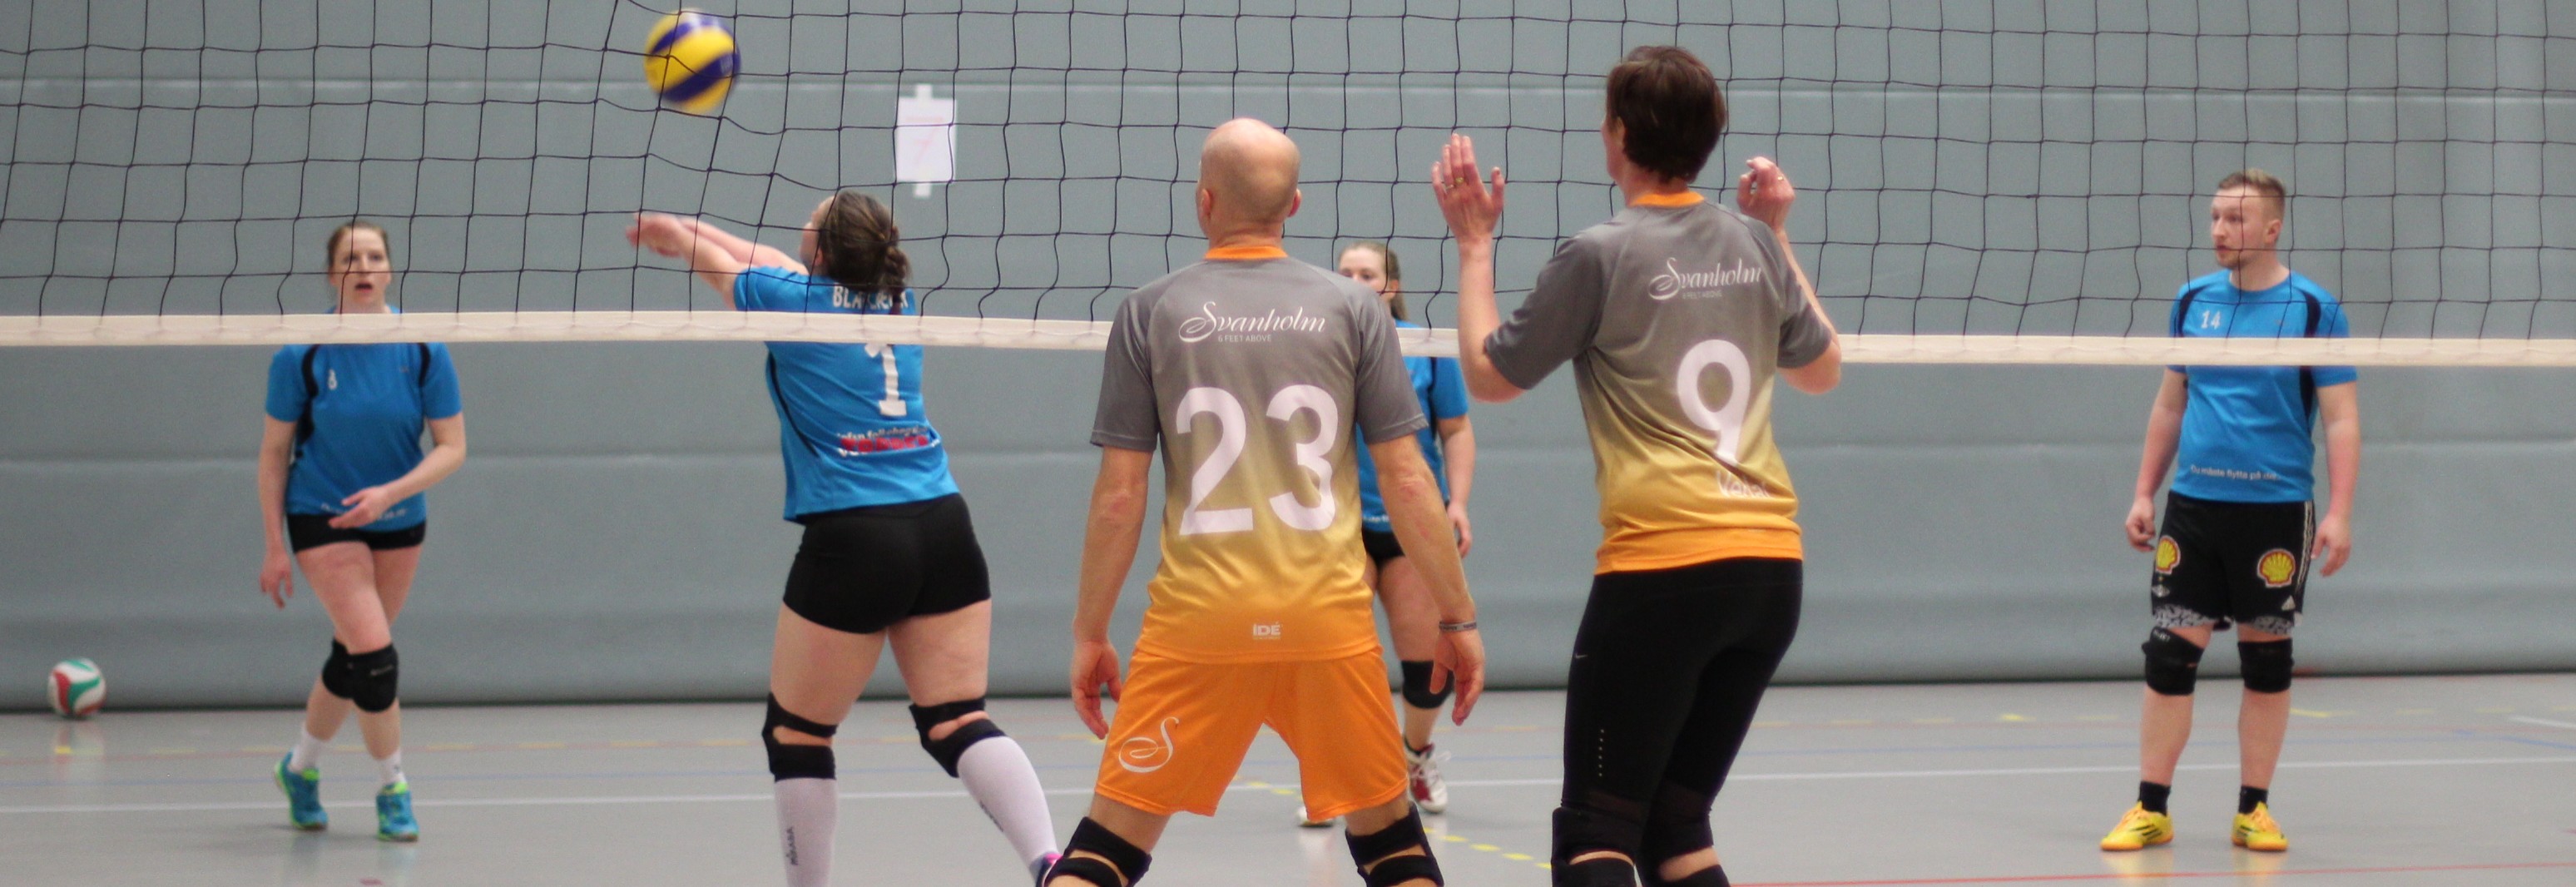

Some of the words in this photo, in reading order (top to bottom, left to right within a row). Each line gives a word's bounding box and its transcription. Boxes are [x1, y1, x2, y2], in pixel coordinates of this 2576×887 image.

[1647, 257, 1761, 300] Svanholm
[1178, 301, 1325, 343] Svanholm
[1218, 334, 1223, 343] 6
[1225, 334, 1243, 343] FEET
[1246, 334, 1271, 343] ABOVE
[2201, 310, 2221, 330] 14
[864, 342, 907, 416] 1
[1677, 339, 1751, 466] 9
[1176, 384, 1339, 535] 23
